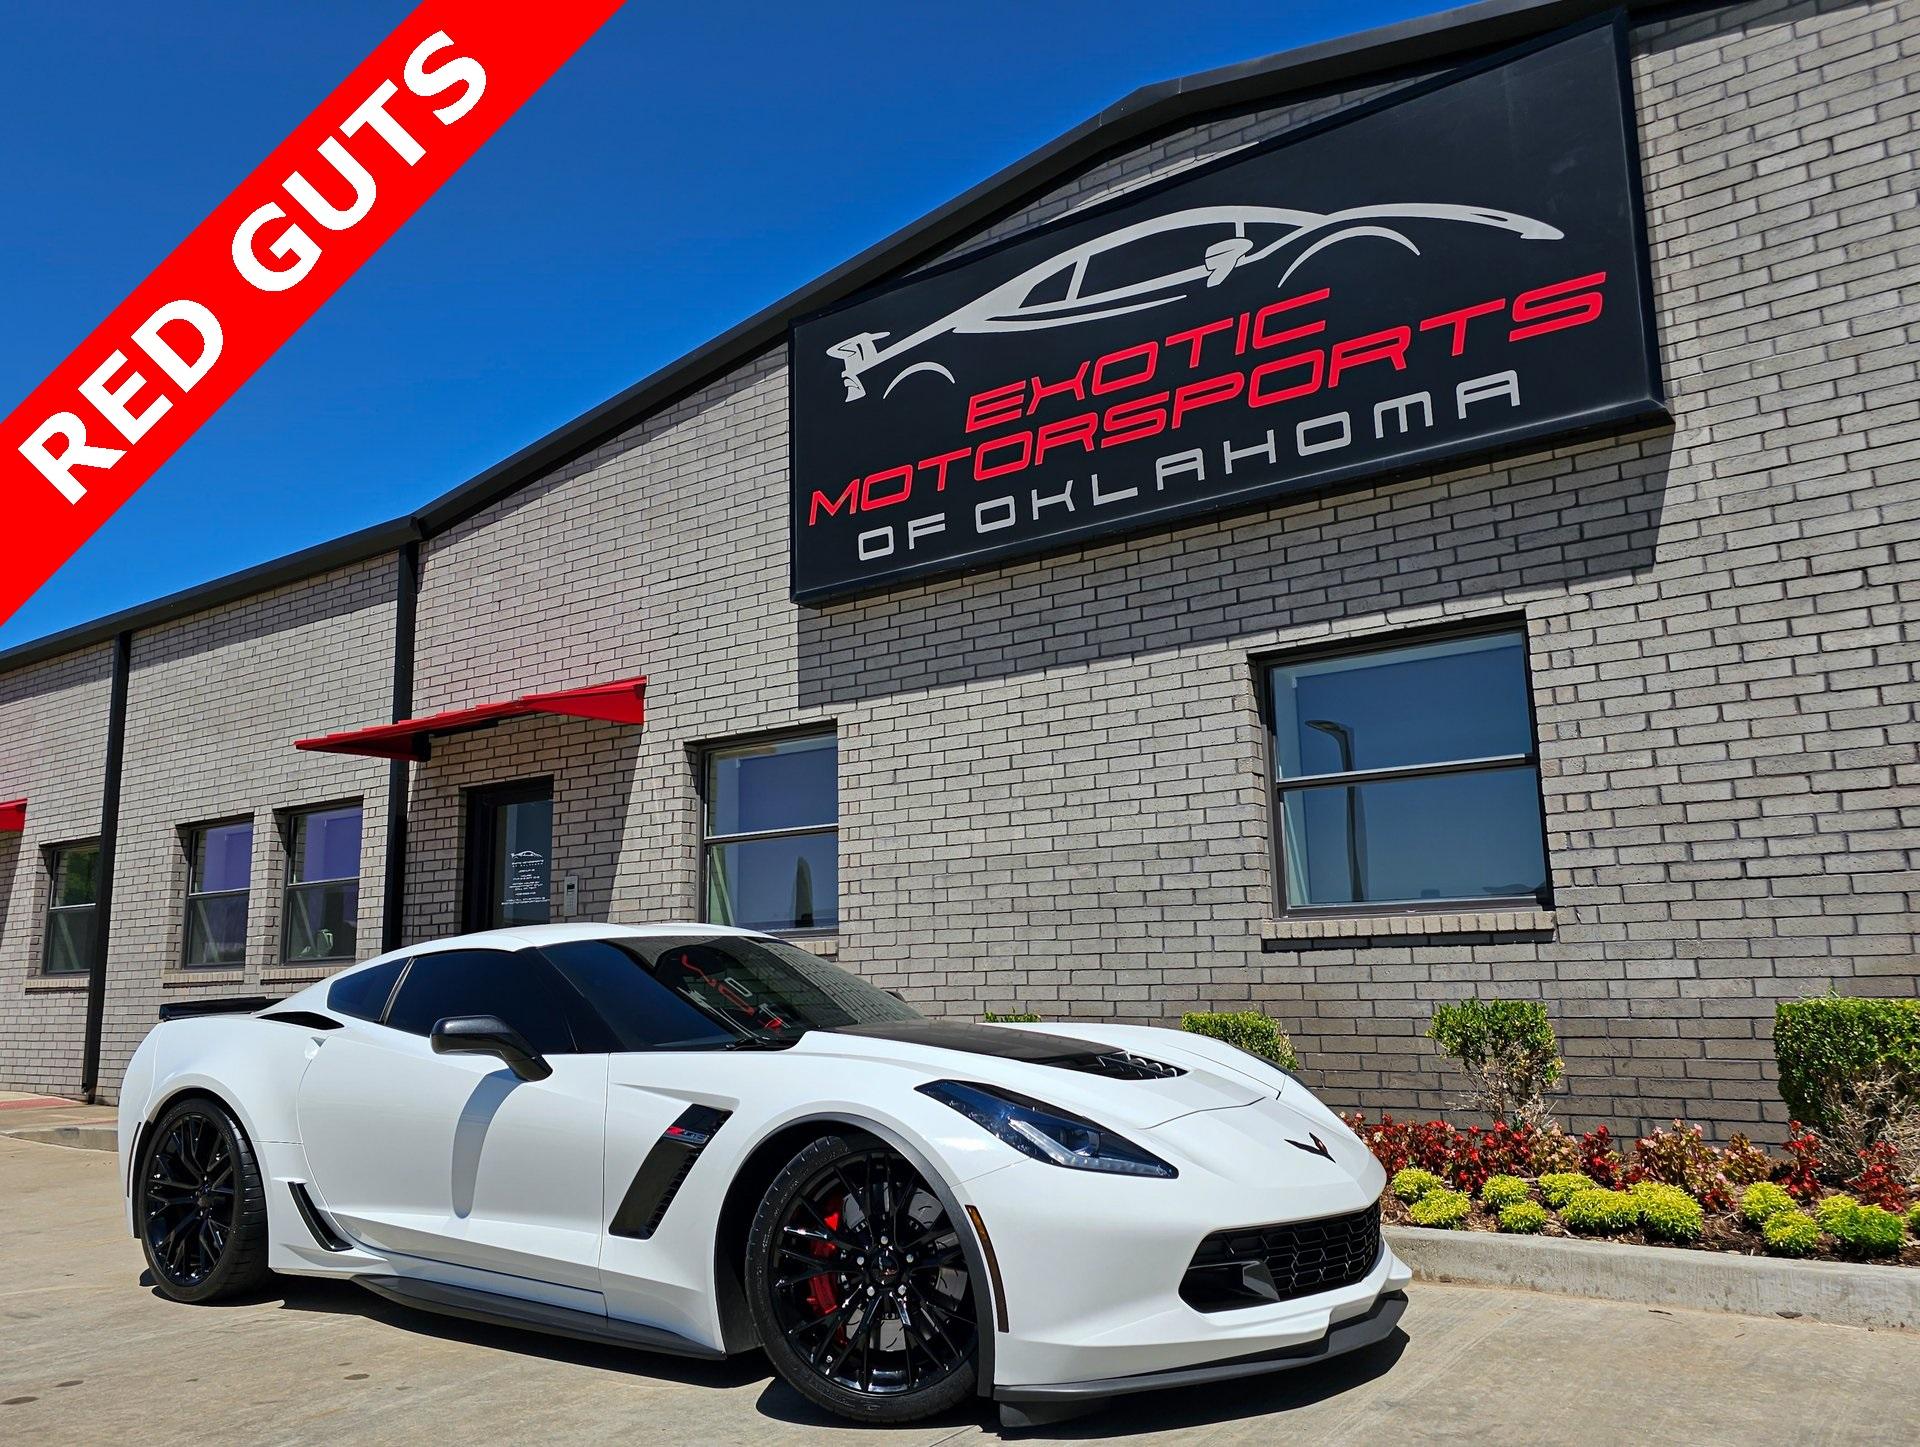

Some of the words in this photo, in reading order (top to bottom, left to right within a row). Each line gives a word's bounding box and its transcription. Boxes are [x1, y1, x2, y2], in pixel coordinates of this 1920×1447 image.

[809, 271, 1606, 526] MOTORSPORTS
[965, 287, 1330, 433] EXOTIC
[857, 512, 946, 561] OF
[975, 369, 1521, 534] OKLAHOMA
